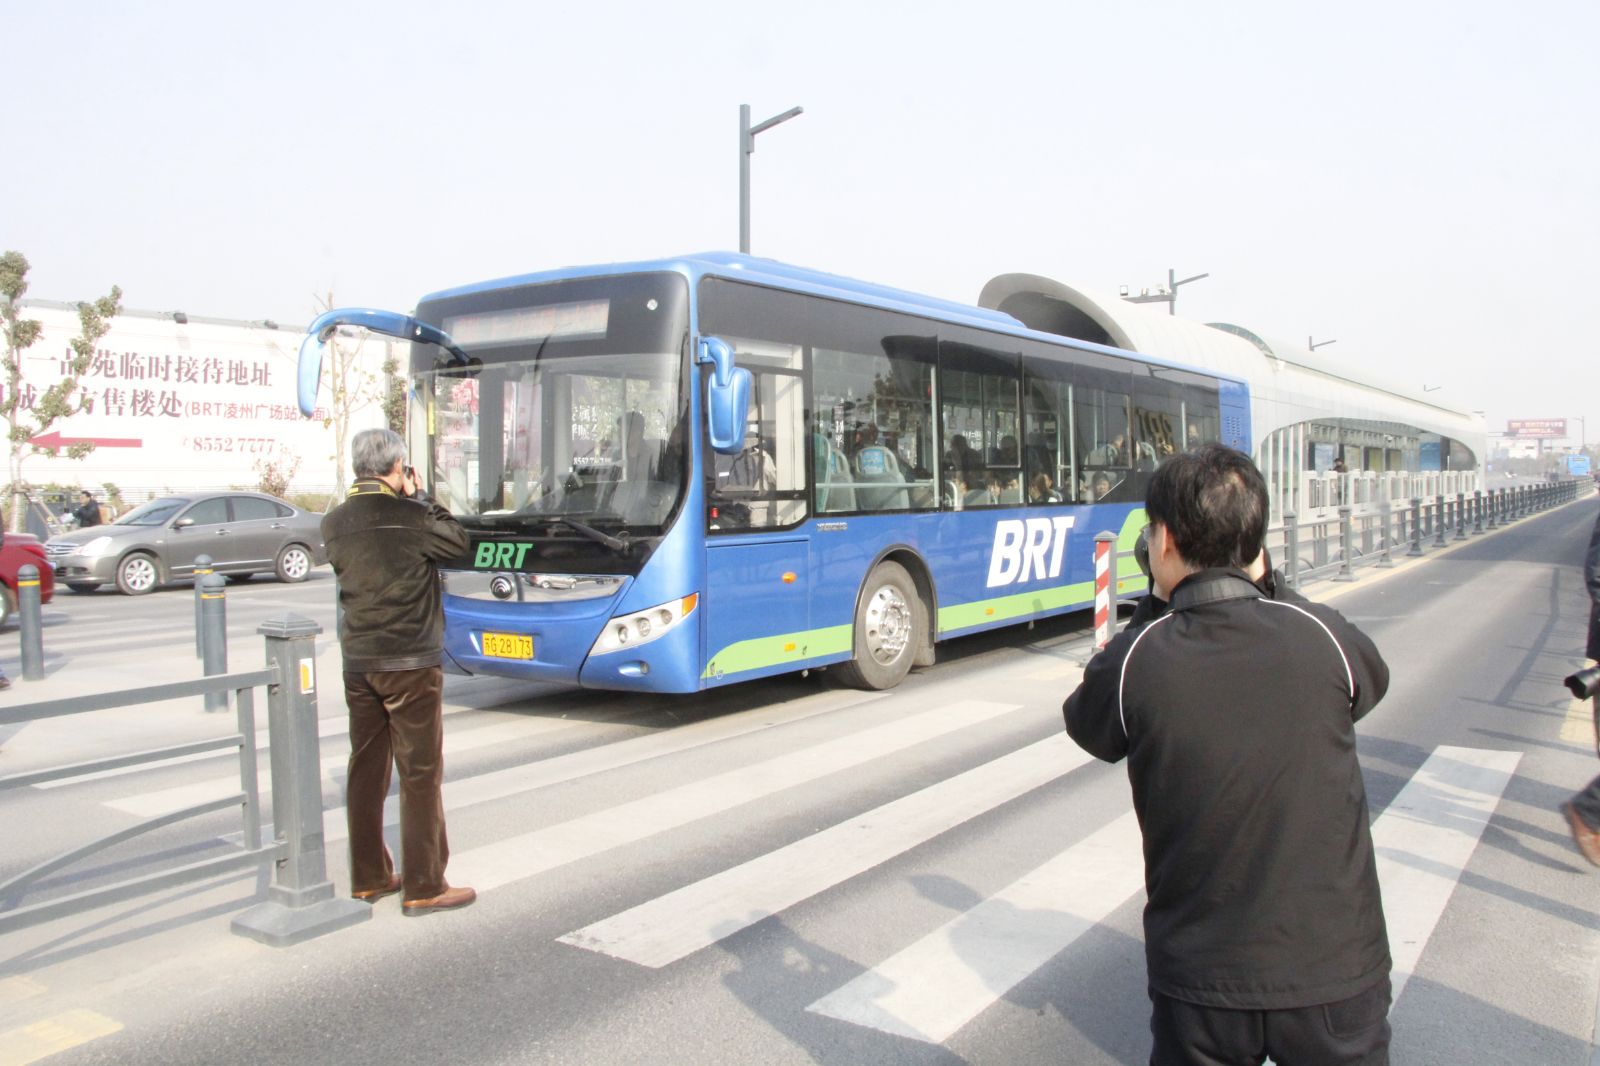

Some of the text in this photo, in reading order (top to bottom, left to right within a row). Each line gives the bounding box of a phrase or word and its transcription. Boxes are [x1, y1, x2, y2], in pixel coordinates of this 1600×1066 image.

[0, 383, 331, 422] 城方售楼处 (BRT凌州广场站面)
[193, 436, 233, 452] 8552
[474, 541, 534, 569] BRT
[985, 515, 1076, 589] BRT
